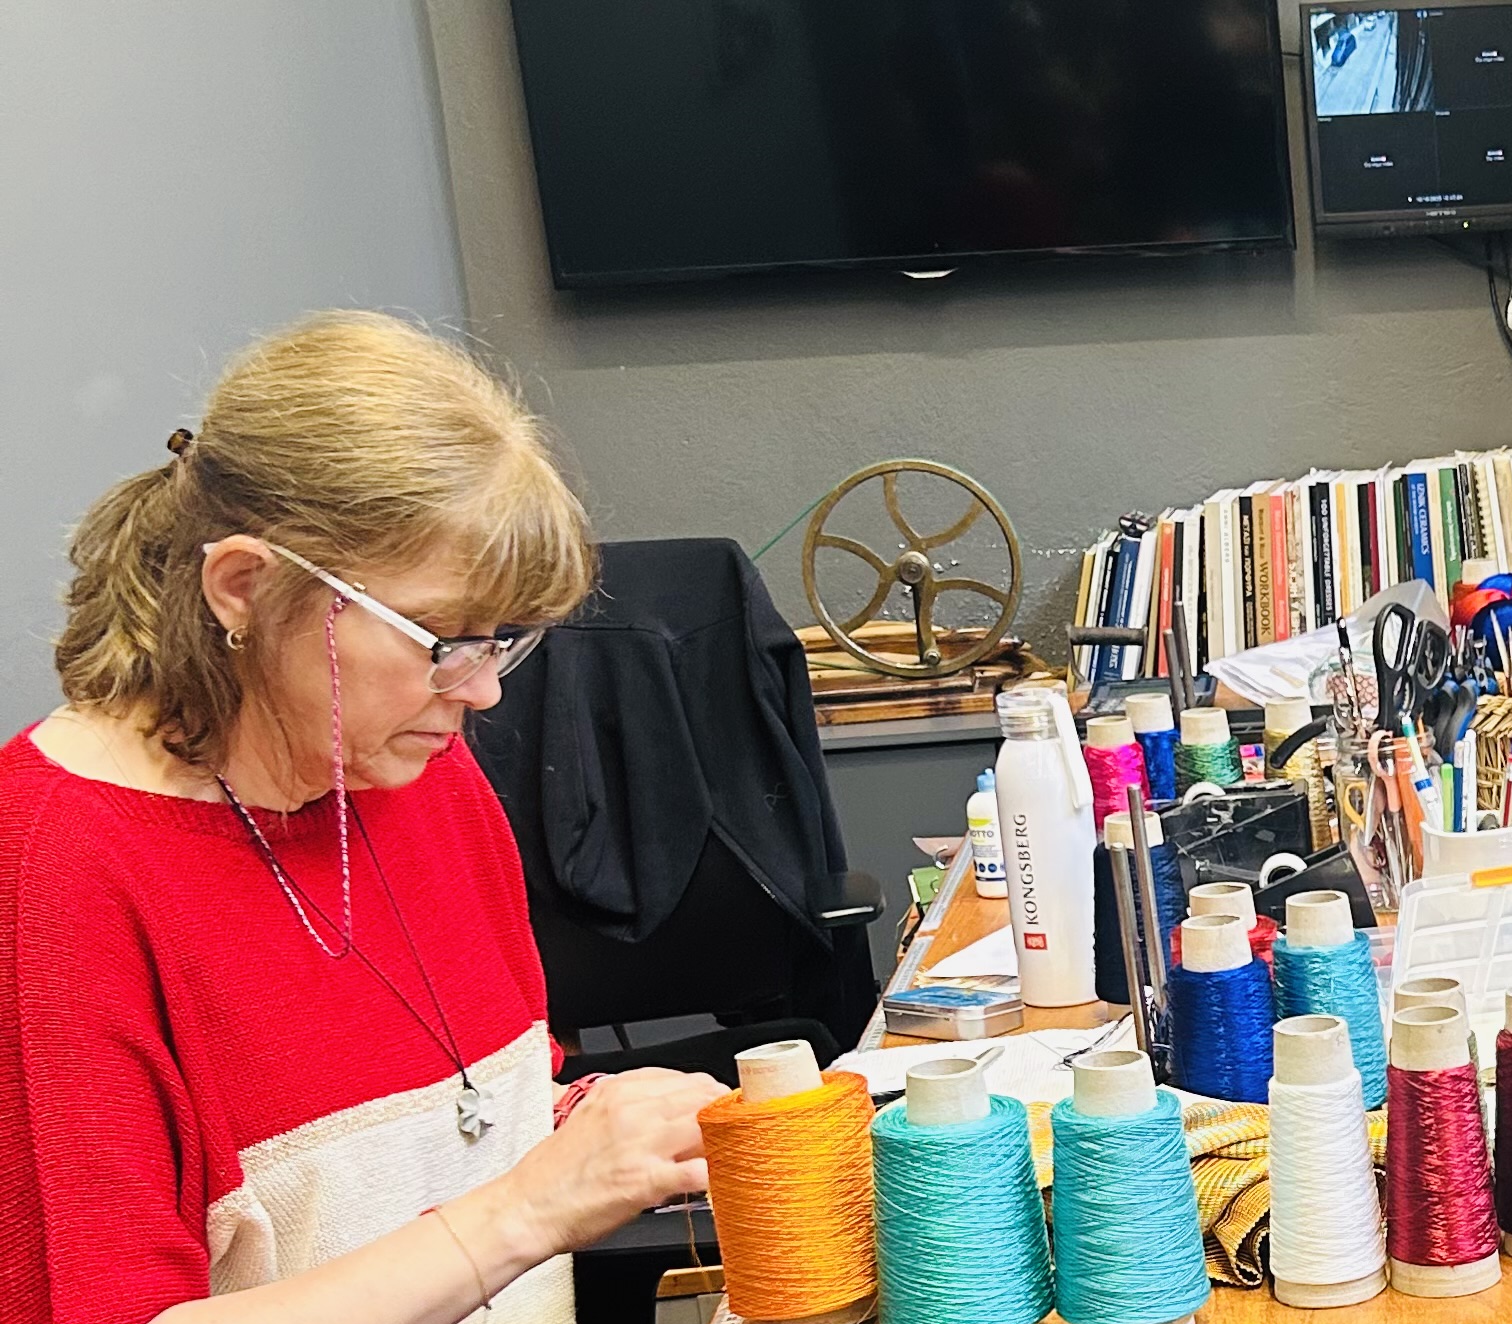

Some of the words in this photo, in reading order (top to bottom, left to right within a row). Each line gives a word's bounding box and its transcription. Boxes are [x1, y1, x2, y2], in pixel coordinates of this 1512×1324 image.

[1320, 498, 1329, 515] 100
[1419, 508, 1430, 555] CERAMICS
[1259, 561, 1272, 637] WORKBOOK
[1013, 813, 1040, 926] KONGSBERG
